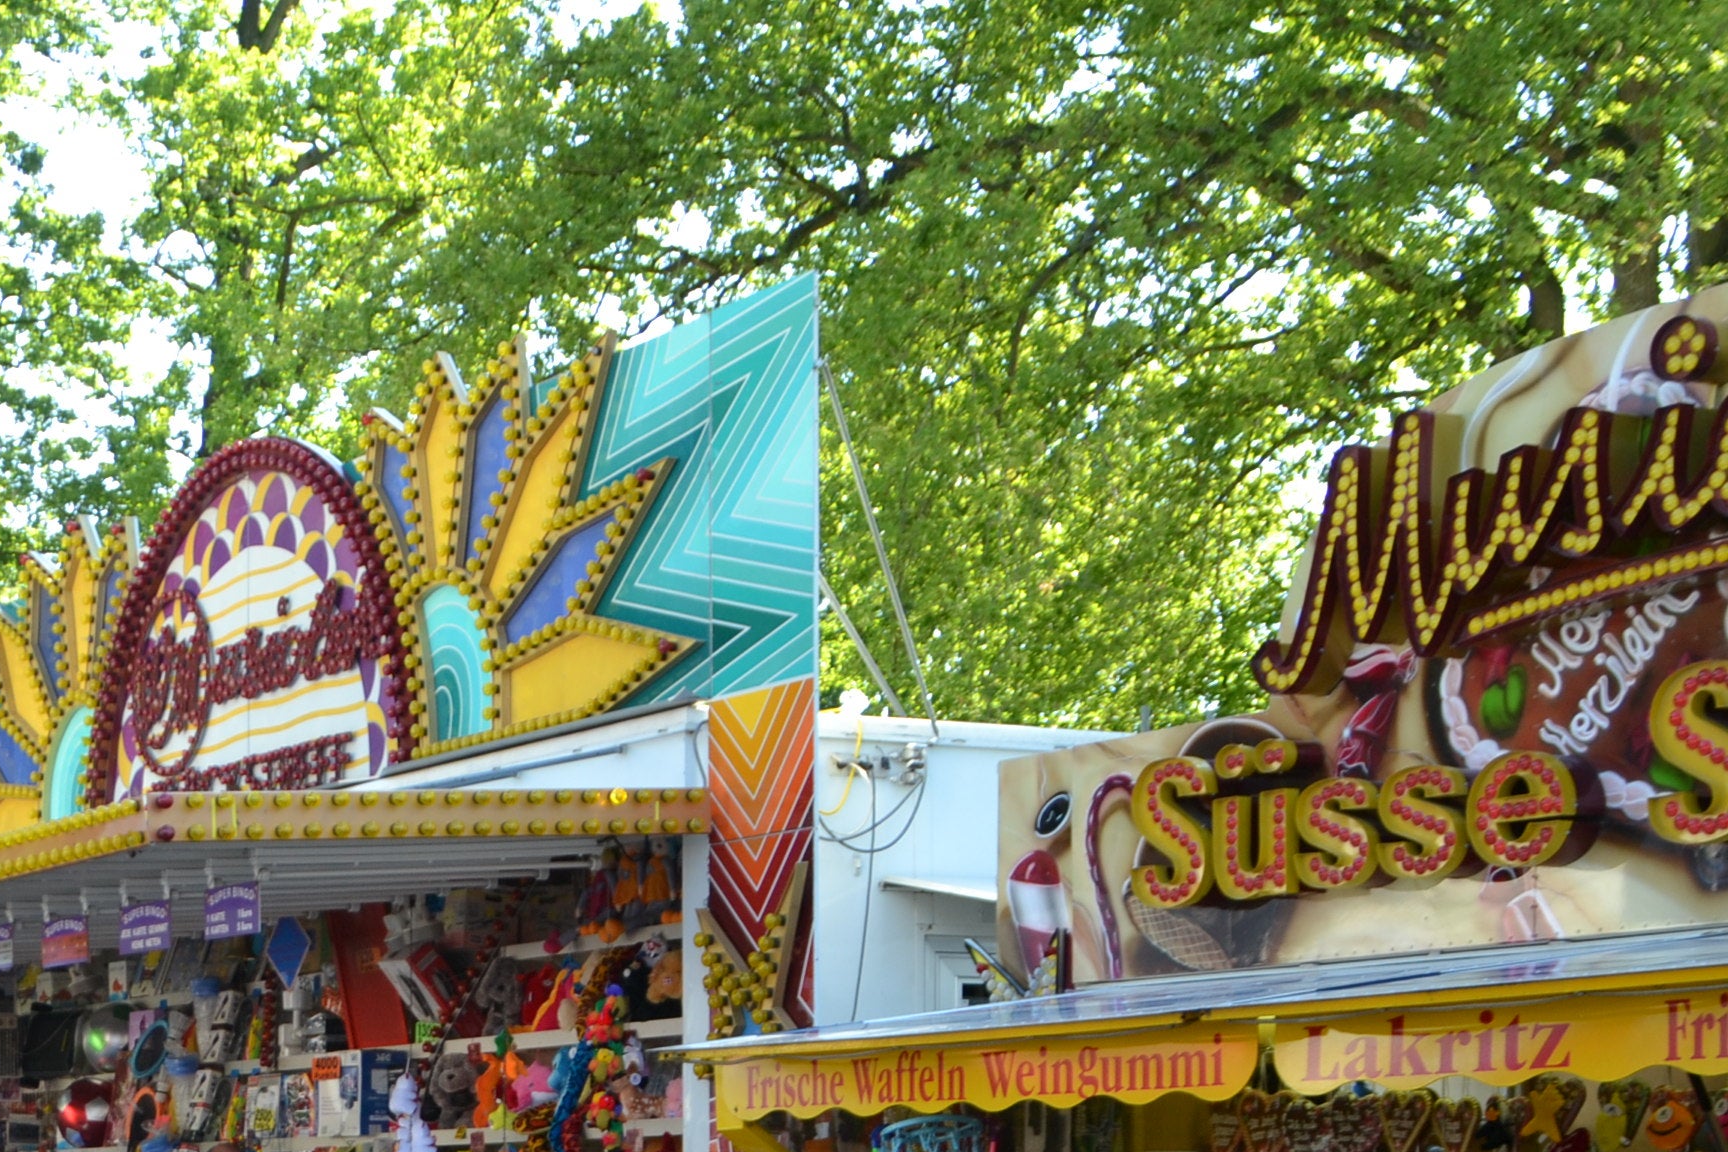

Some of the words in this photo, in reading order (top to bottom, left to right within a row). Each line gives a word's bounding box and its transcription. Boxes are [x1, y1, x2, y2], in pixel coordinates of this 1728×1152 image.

[1251, 314, 1728, 695] Musi
[1131, 738, 1577, 908] Süsse
[746, 1056, 844, 1111] Frische
[851, 1049, 966, 1106] Waffeln
[981, 1033, 1225, 1100] Weingummi
[1301, 1010, 1572, 1082] Lakritz
